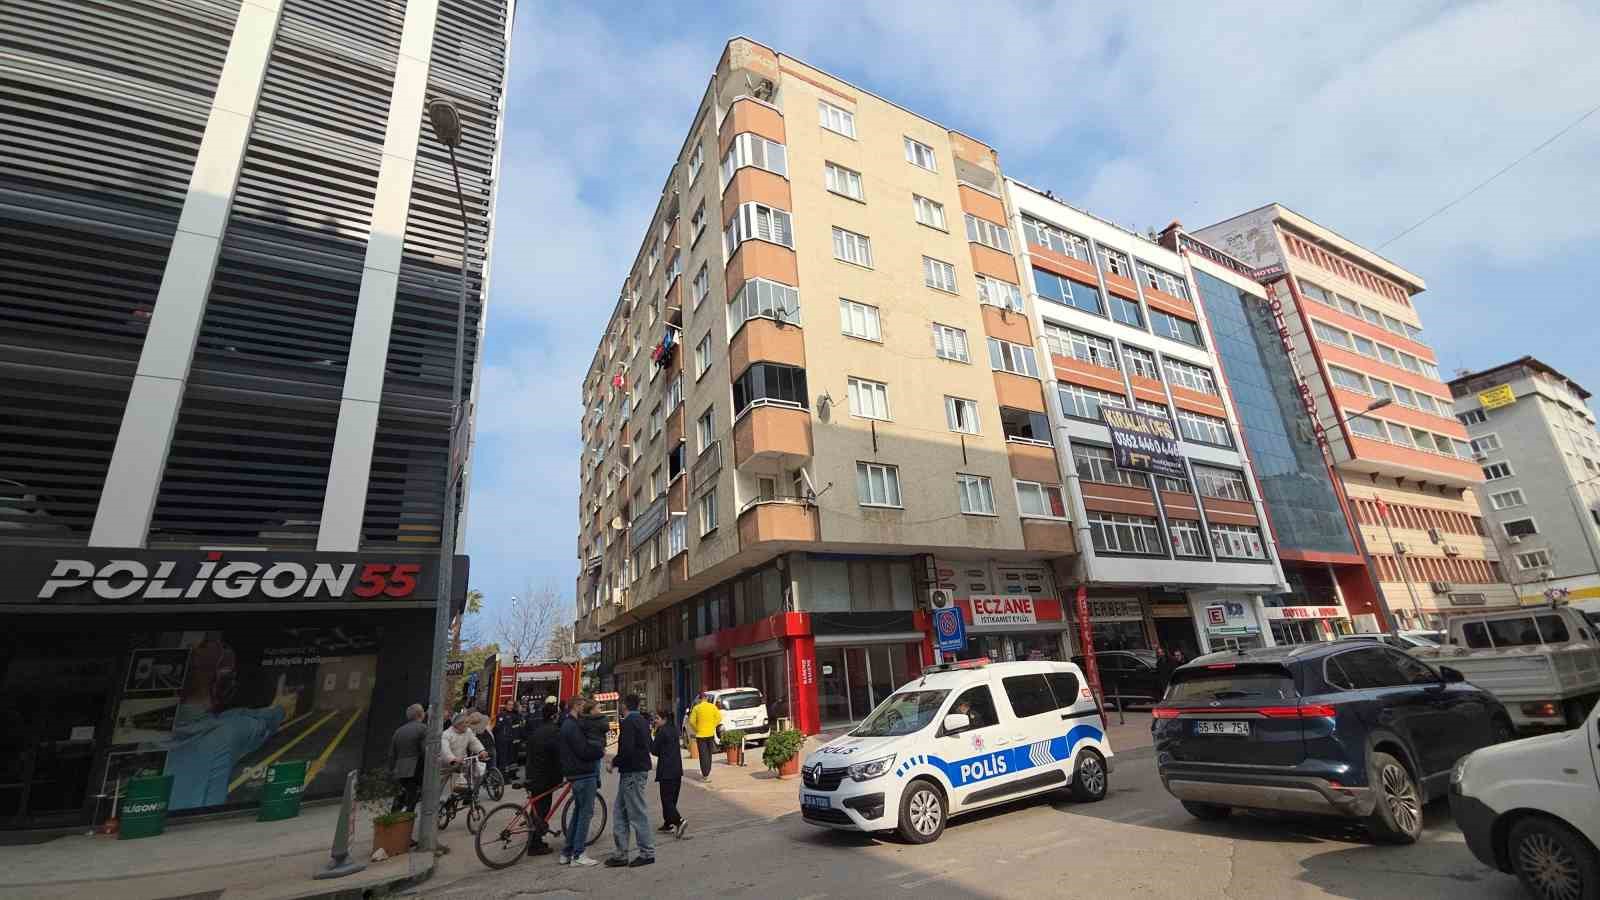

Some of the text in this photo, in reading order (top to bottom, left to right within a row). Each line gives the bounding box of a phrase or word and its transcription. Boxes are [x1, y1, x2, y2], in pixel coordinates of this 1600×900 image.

[1253, 266, 1281, 278] HOTEL
[1265, 284, 1296, 352] HOTEL
[1103, 408, 1152, 434] KIRALIK
[352, 563, 422, 598] 55
[974, 599, 1032, 614] ECZANE
[961, 754, 1007, 783] POLİS
